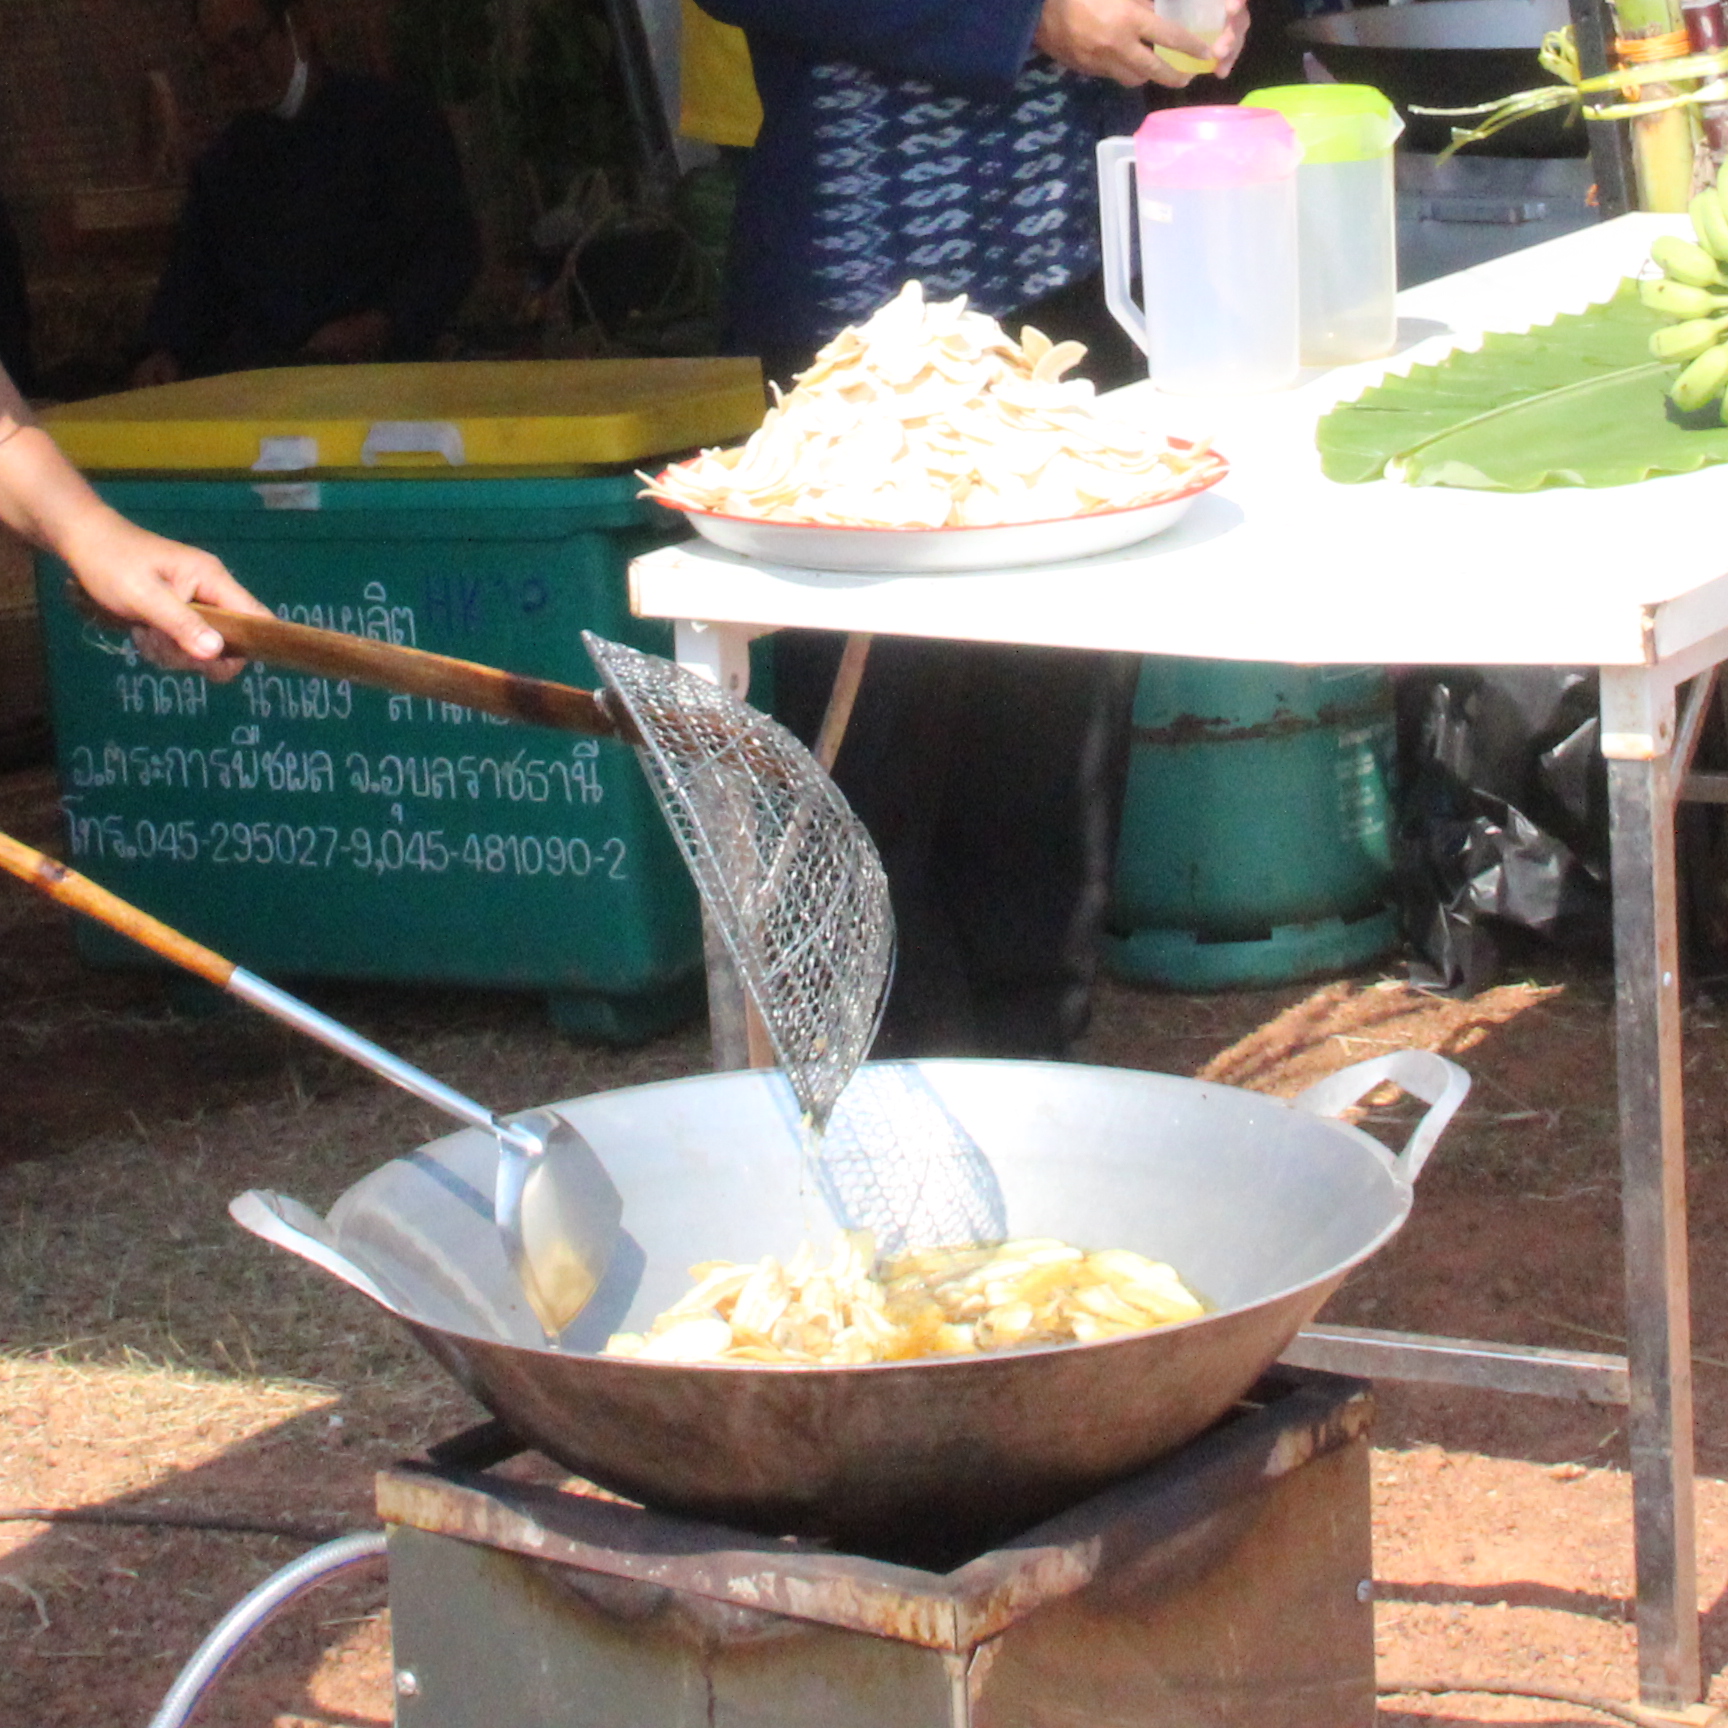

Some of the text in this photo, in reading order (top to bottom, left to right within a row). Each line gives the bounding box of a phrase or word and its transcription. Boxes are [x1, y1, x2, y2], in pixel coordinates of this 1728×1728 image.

[346, 739, 605, 826] จ.อุบลราชธานี
